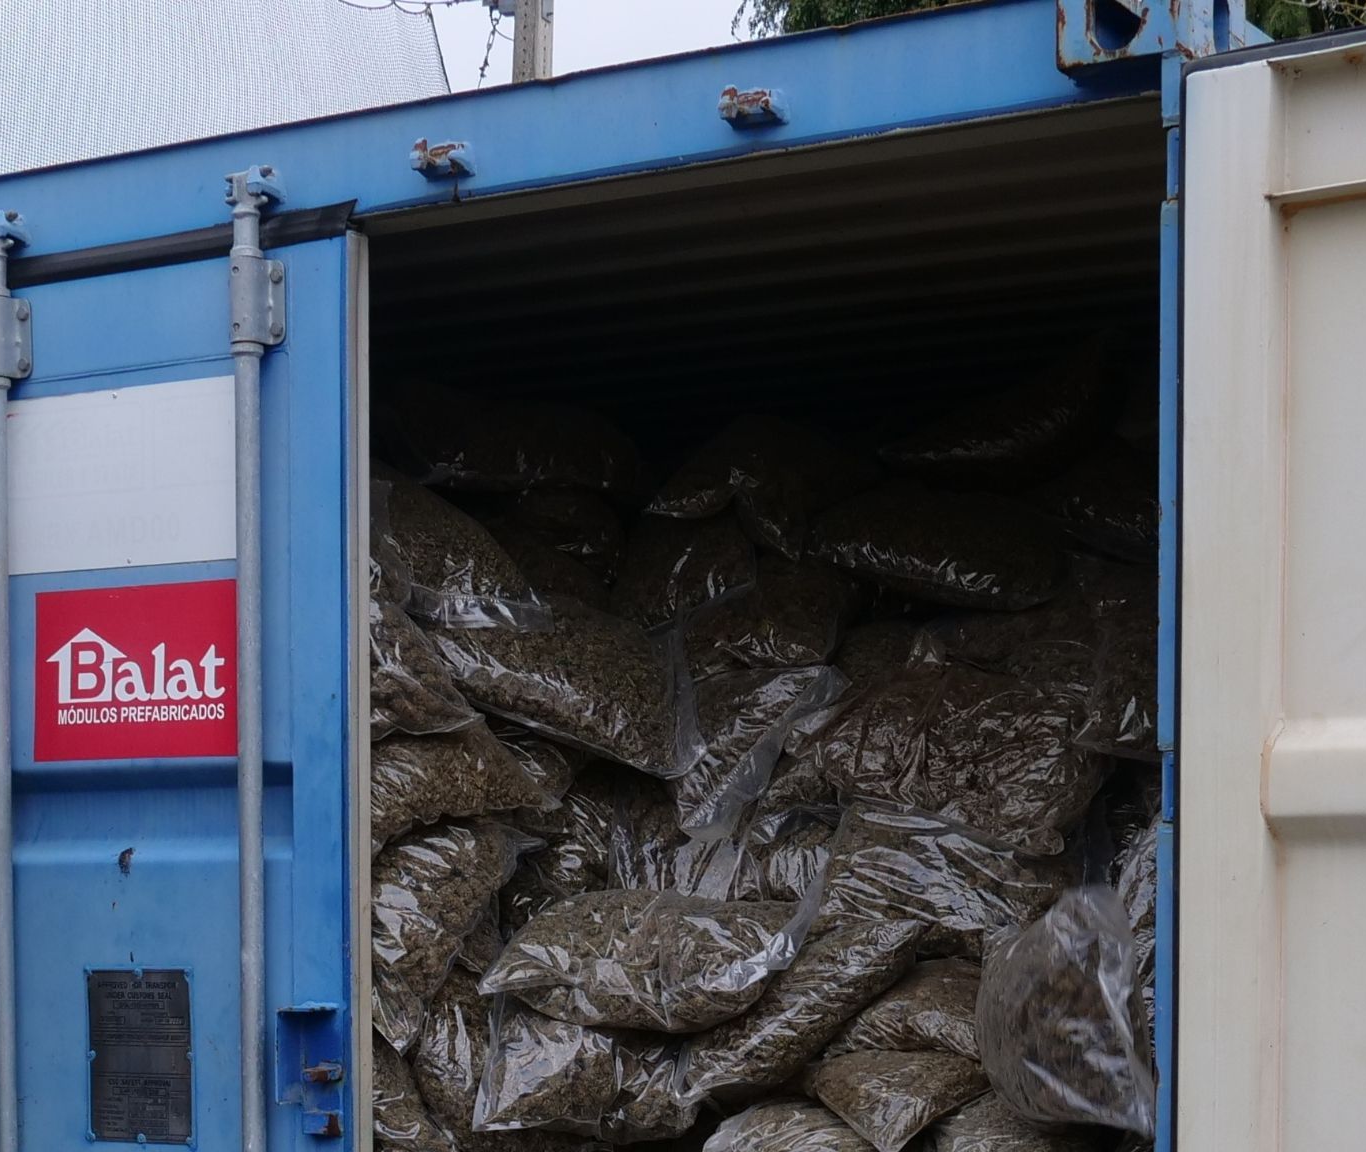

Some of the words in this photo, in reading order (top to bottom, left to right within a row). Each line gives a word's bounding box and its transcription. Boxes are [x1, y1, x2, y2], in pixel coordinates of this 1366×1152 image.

[68, 640, 226, 702] Balat
[58, 705, 117, 725] MÓDULOS
[120, 703, 225, 722] PREFABRICADOS
